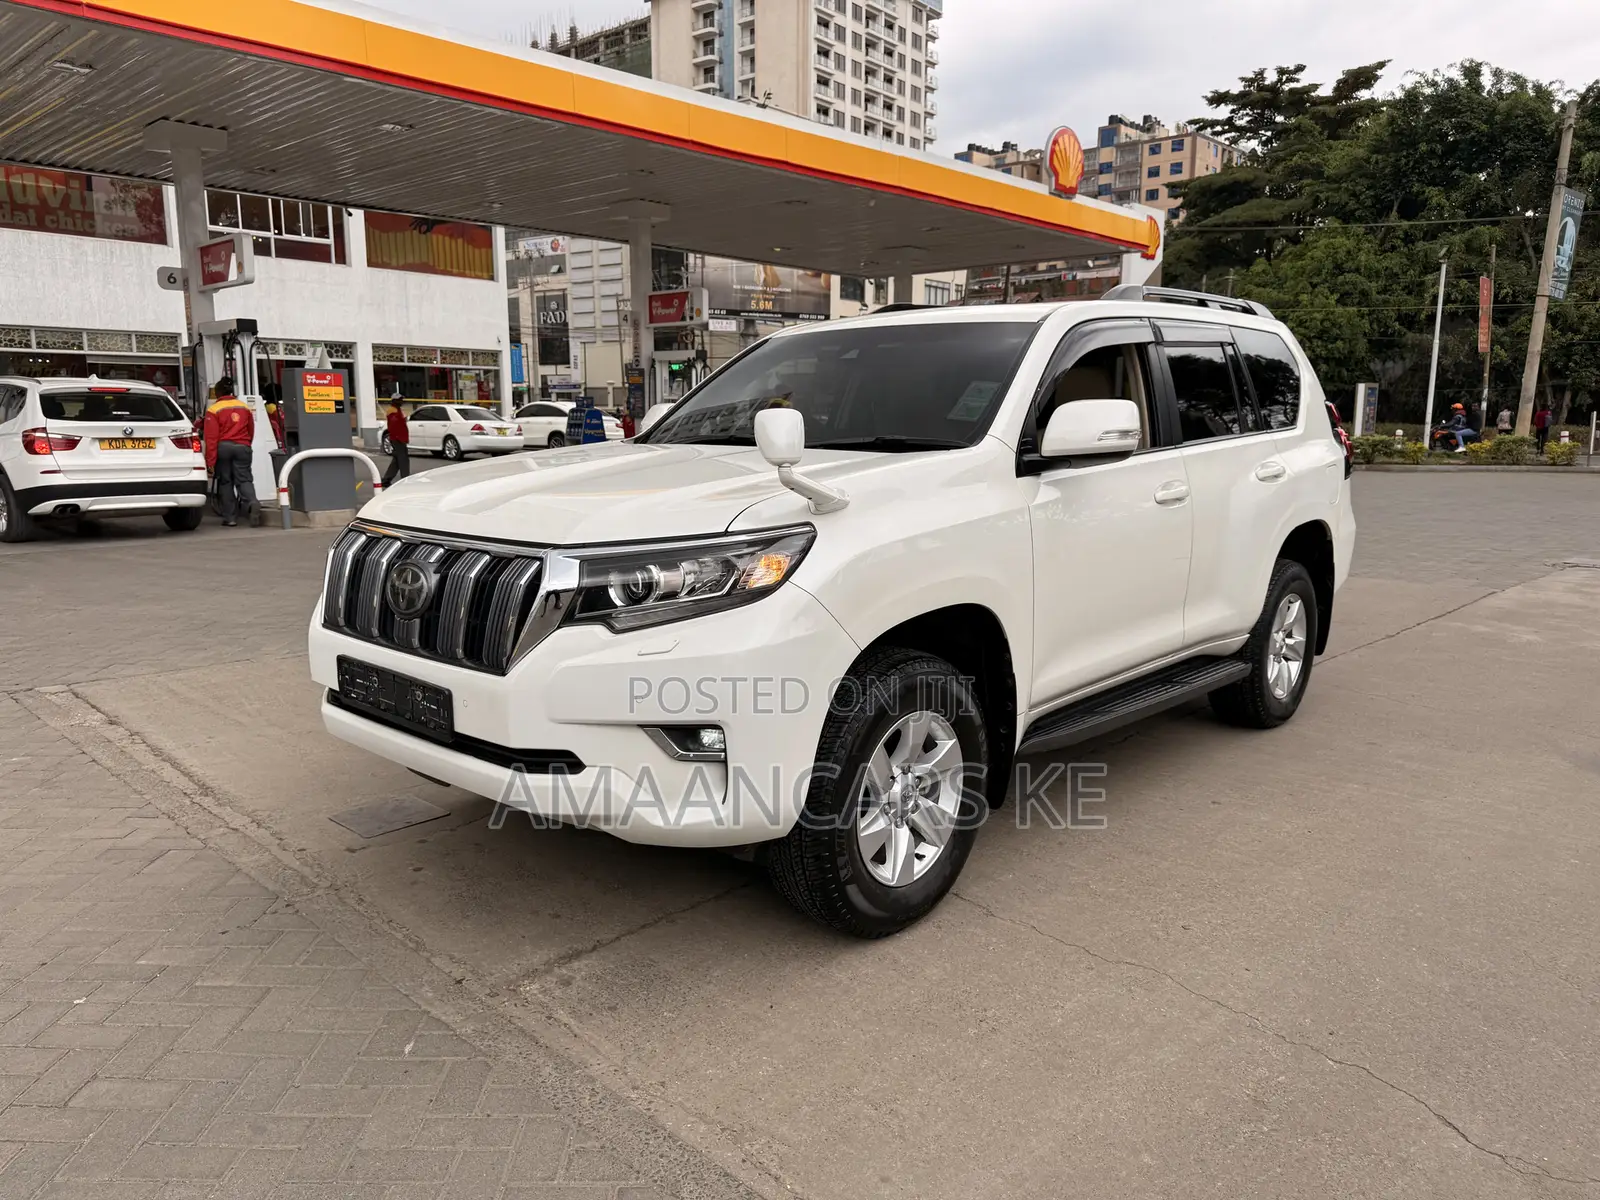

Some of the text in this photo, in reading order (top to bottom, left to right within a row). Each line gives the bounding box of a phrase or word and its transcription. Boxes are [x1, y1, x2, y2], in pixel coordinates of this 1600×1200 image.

[166, 272, 178, 284] 6
[750, 300, 773, 310] 5.6M
[622, 314, 628, 324] 4
[107, 439, 128, 449] KDA
